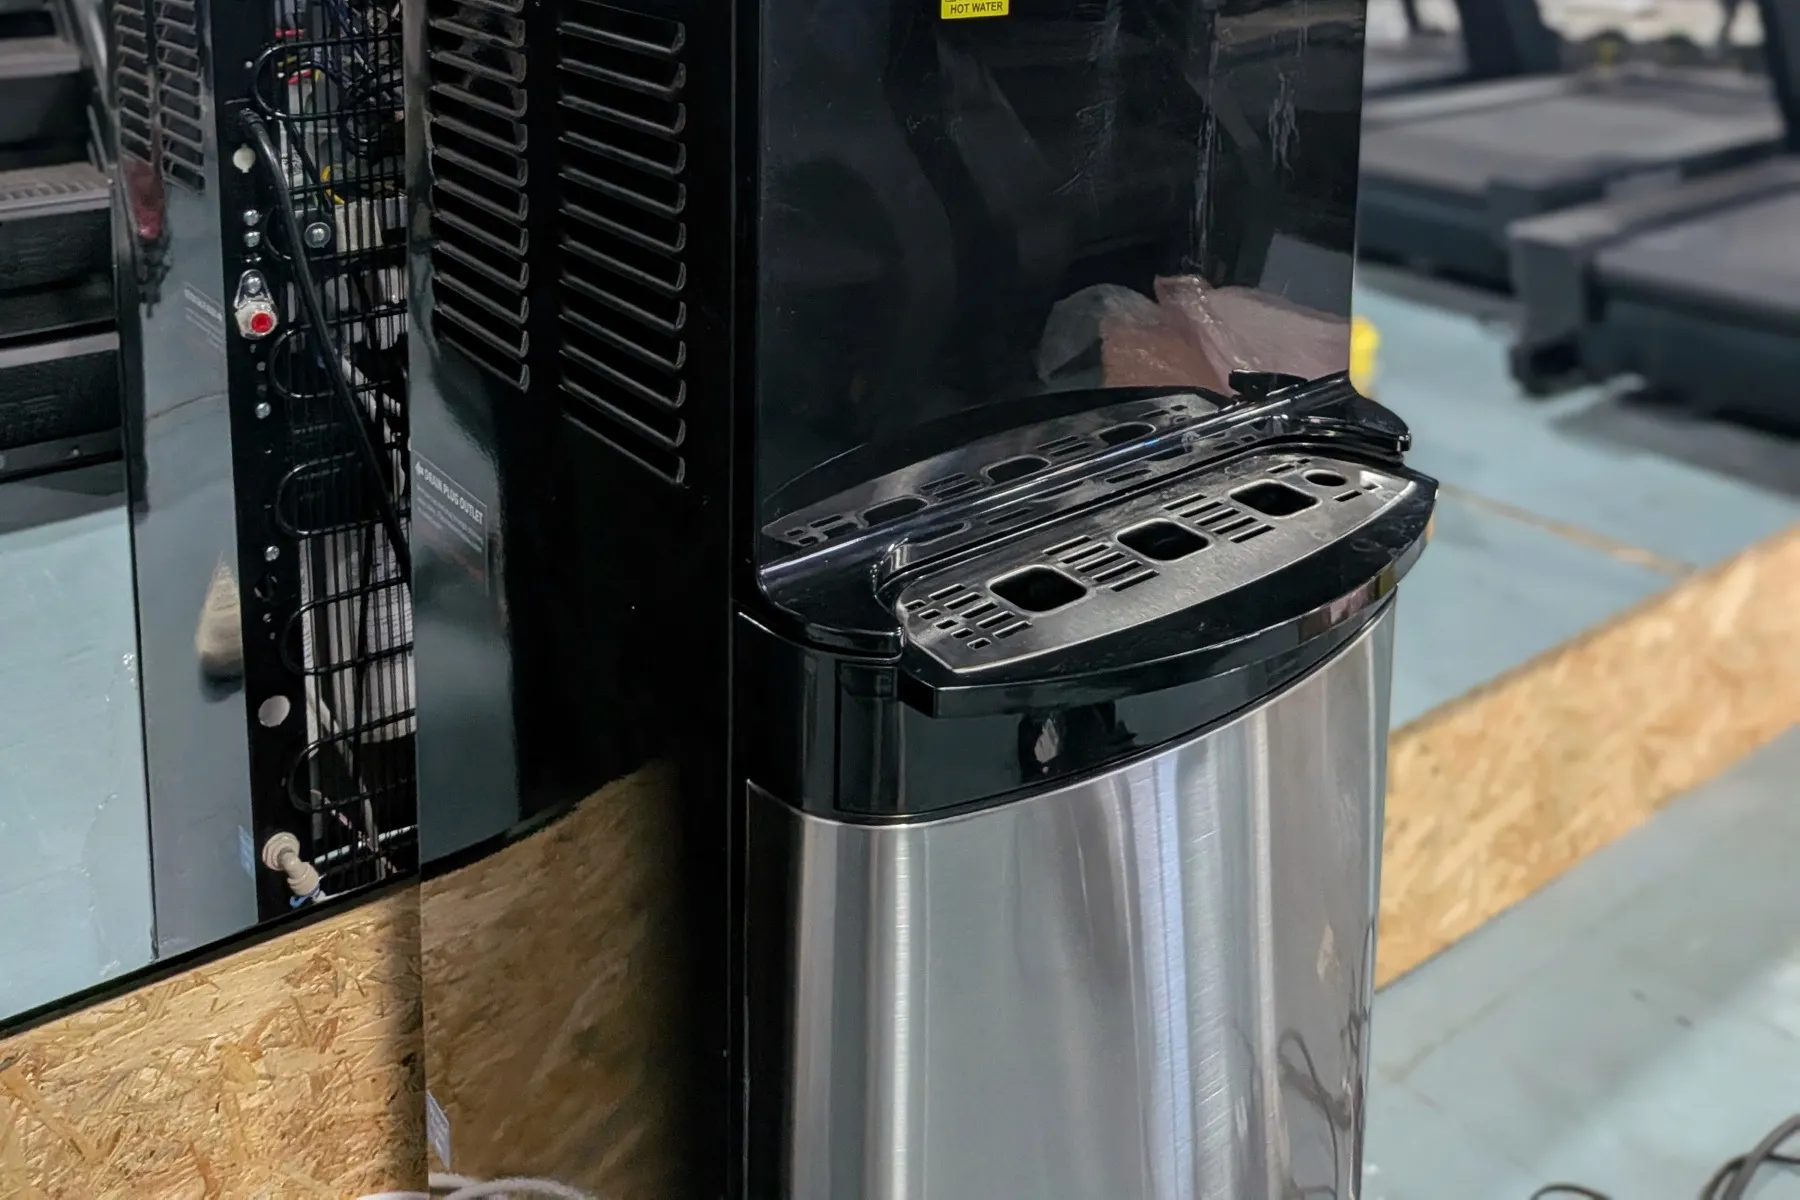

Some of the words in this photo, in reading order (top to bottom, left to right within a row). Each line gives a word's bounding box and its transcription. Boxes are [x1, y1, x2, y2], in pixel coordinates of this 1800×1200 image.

[950, 3, 969, 14] HOT
[972, 1, 1003, 13] WATER
[424, 468, 443, 492] DRAIN
[443, 483, 459, 505] PLUG
[459, 497, 483, 525] OUTLET
